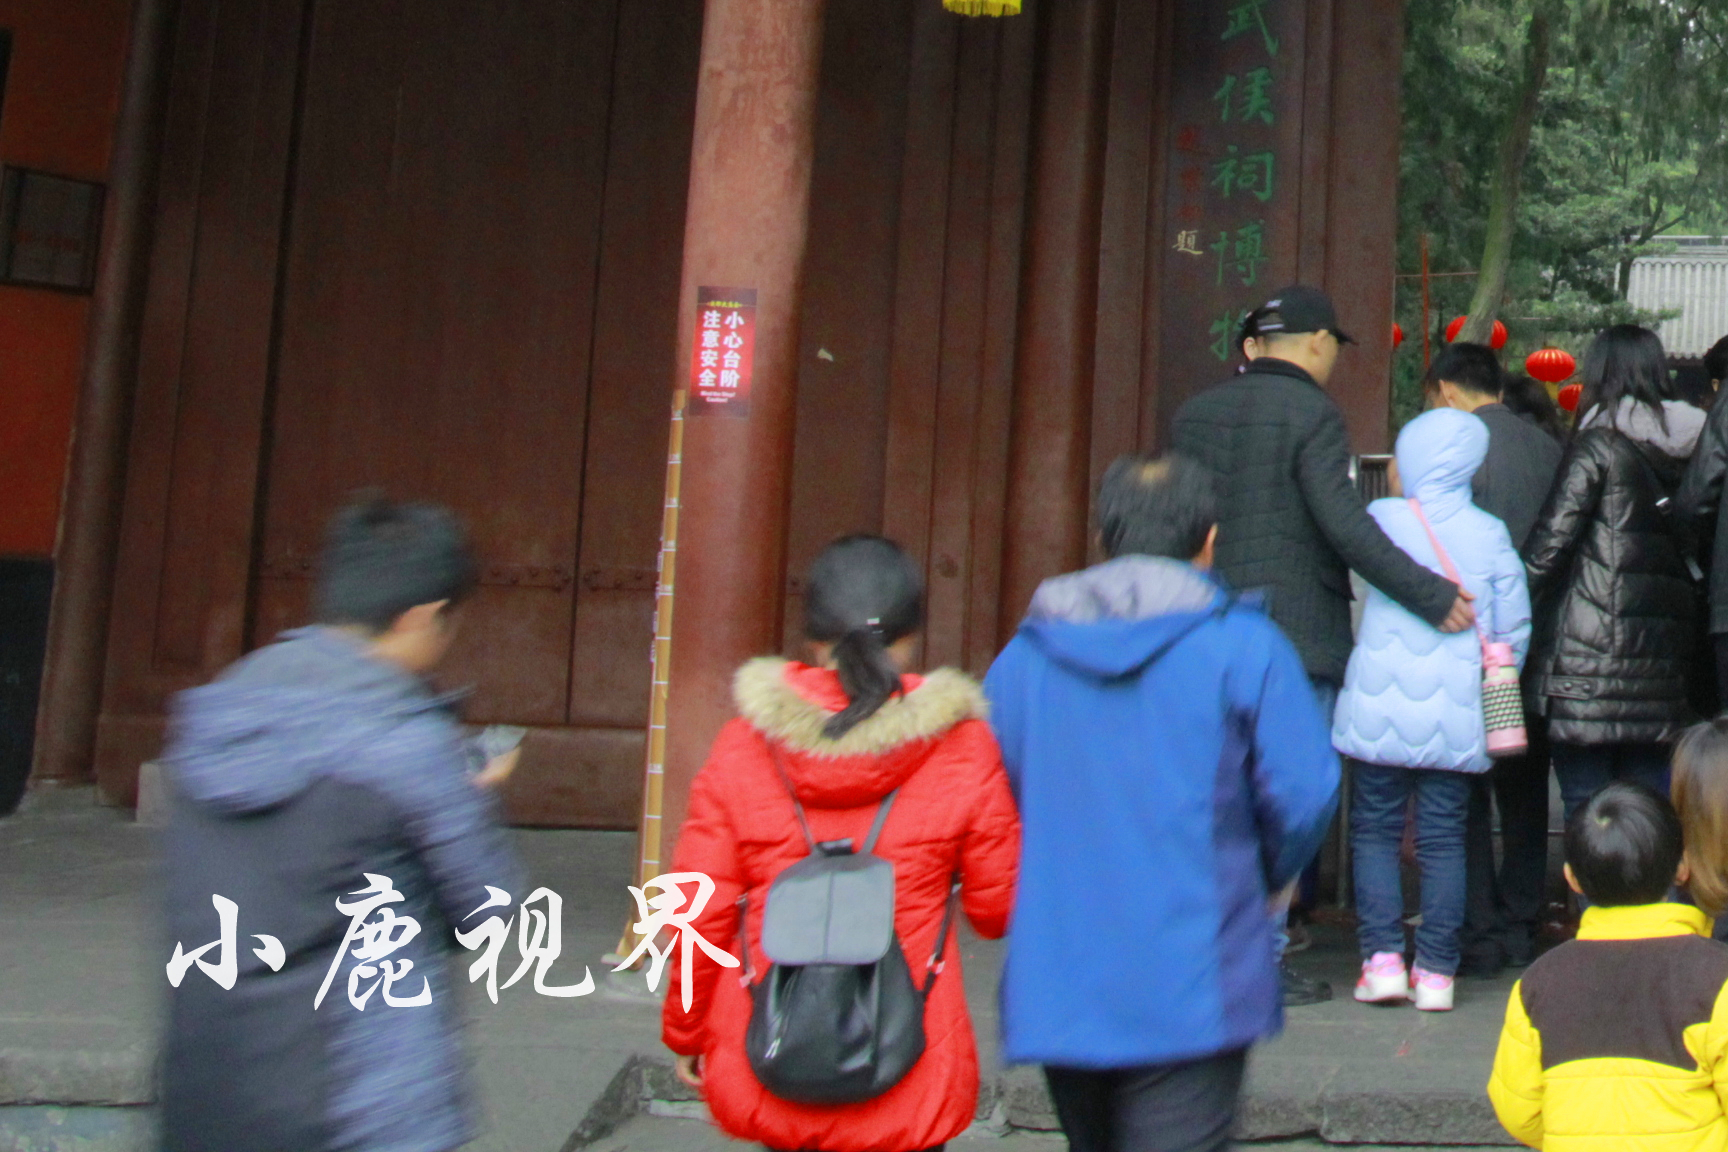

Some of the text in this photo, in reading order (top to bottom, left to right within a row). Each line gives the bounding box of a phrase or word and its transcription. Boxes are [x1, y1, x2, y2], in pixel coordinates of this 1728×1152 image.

[699, 309, 722, 387] 注意安全
[719, 311, 744, 388] 小心台阶
